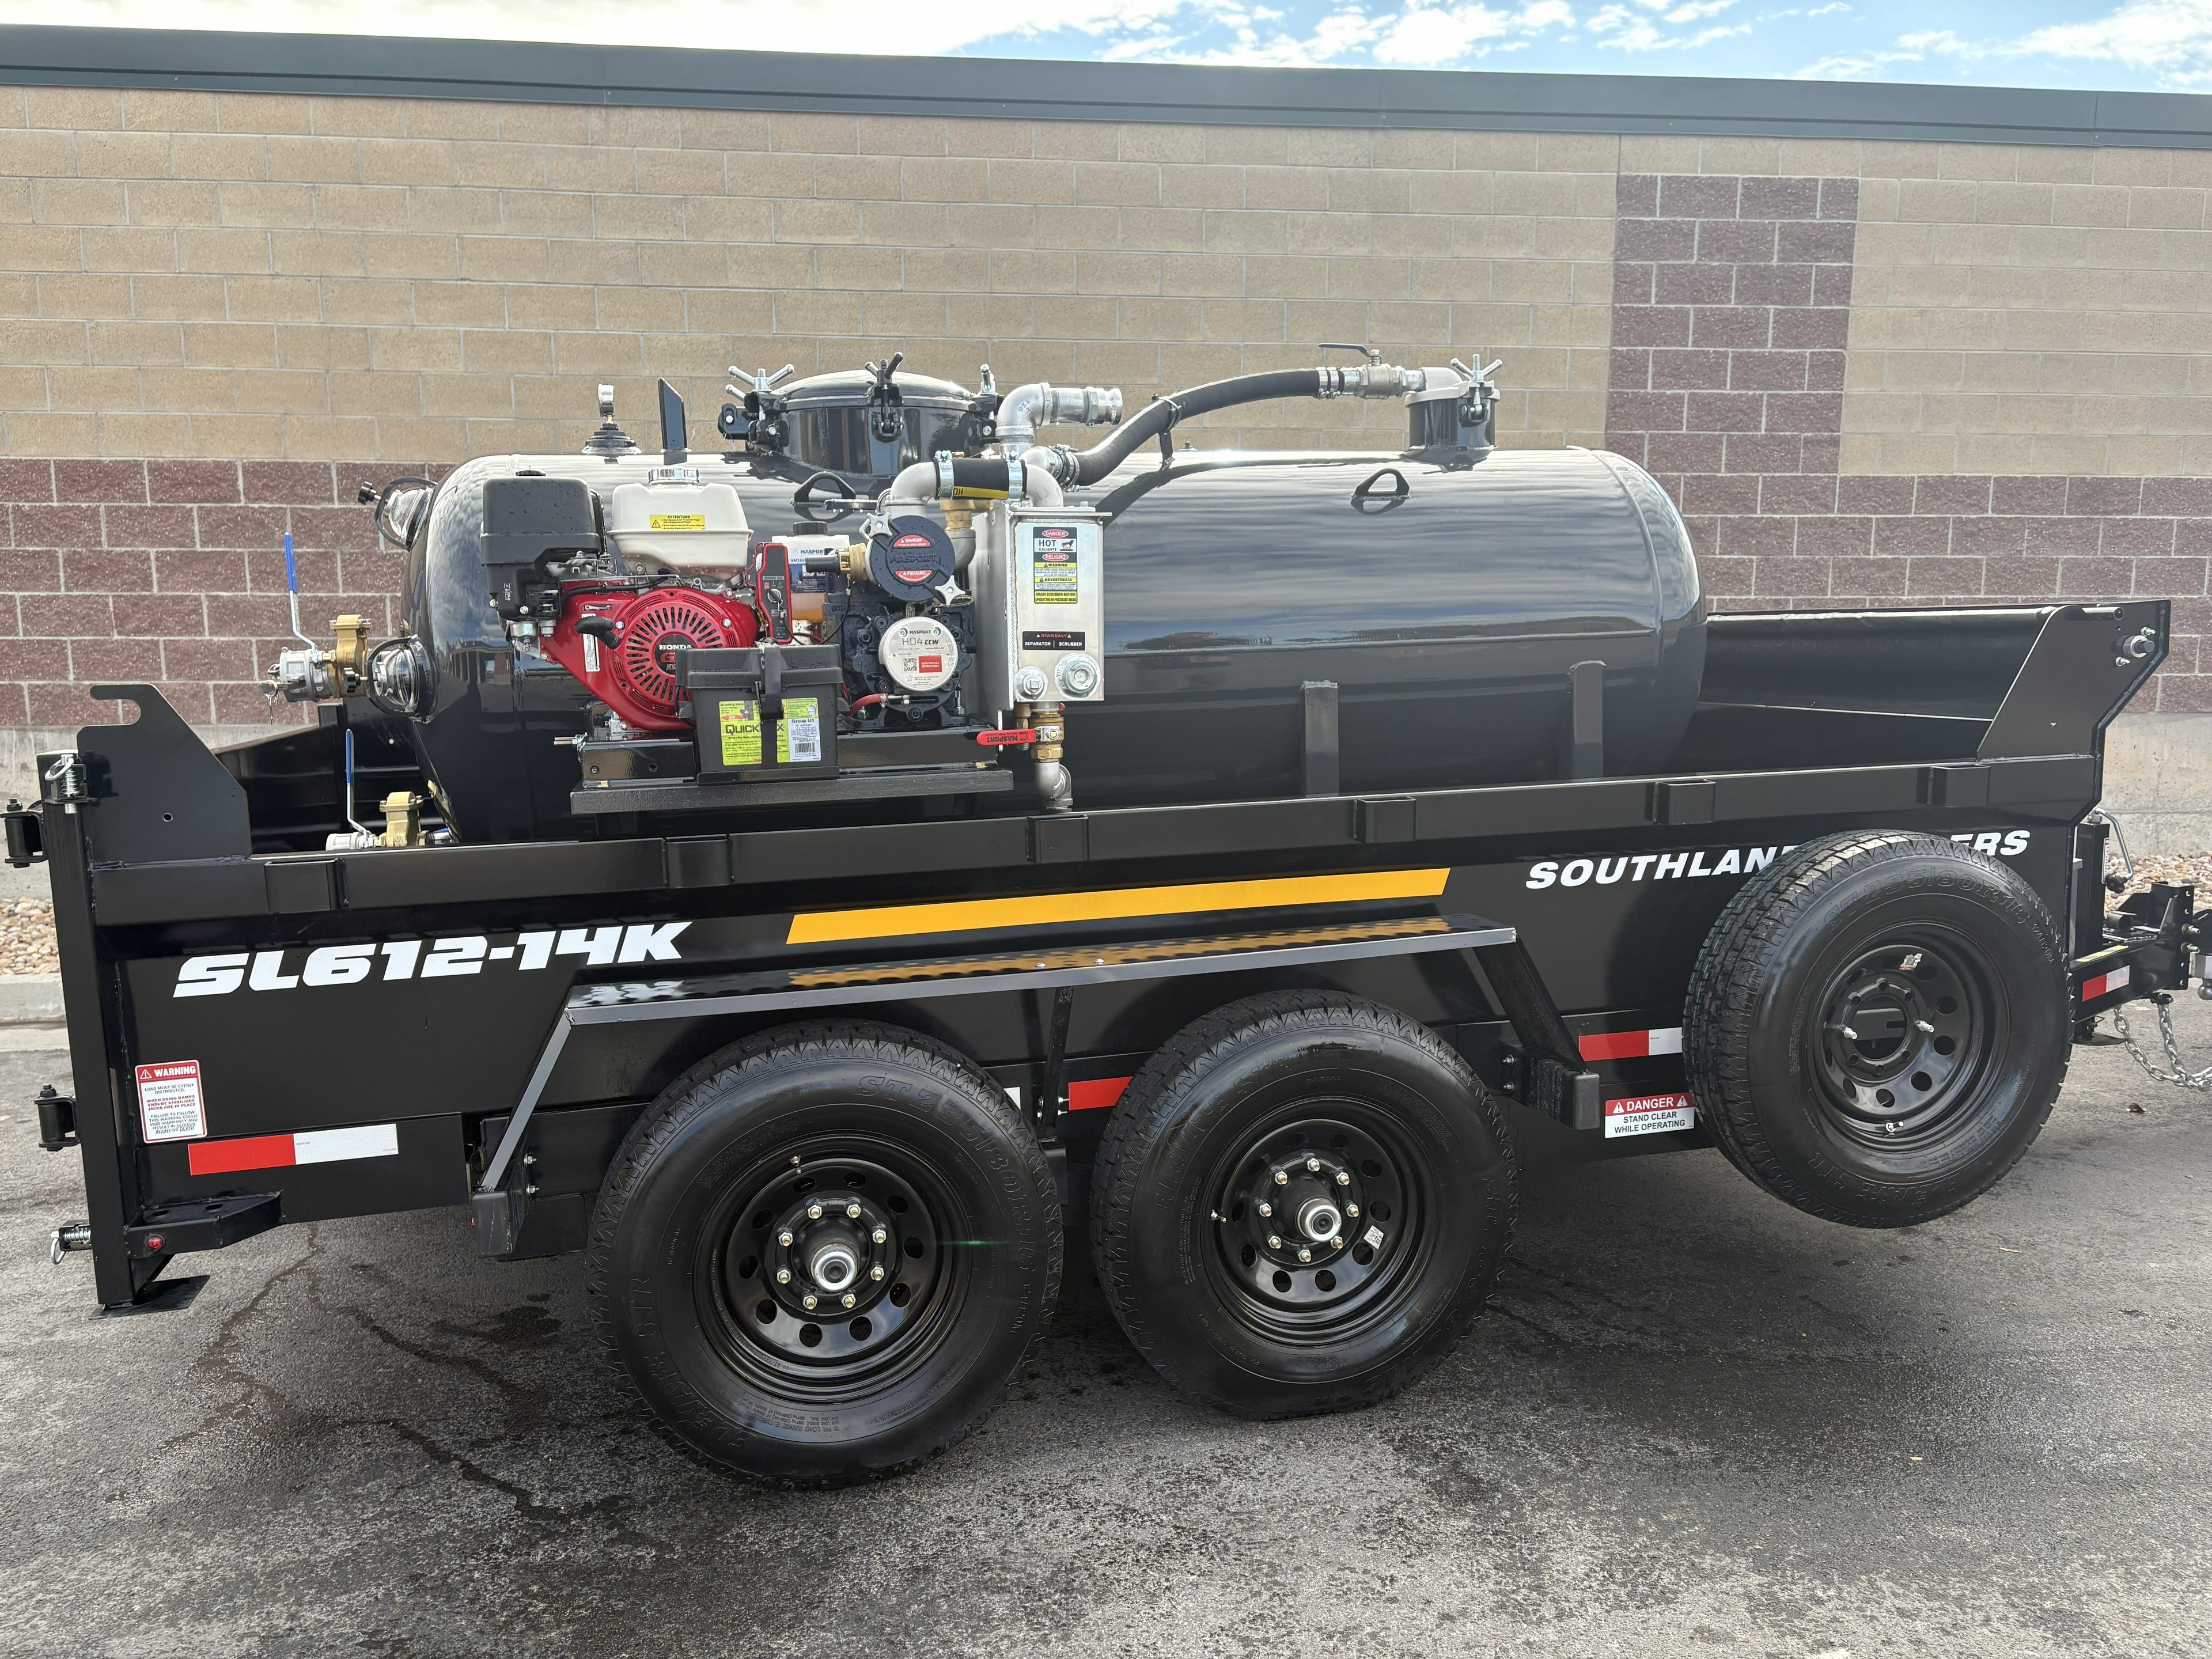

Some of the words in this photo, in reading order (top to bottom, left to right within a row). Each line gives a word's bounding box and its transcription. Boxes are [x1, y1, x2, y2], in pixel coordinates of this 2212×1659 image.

[1039, 539, 1056, 547] HOT
[902, 637, 922, 646] HD4
[1525, 845, 1798, 889] SOUTHLAN
[173, 921, 693, 998] SL612-14K
[154, 1066, 196, 1078] WARNING
[854, 1075, 912, 1101] ST
[1627, 1097, 1674, 1111] DANGER
[1623, 1115, 1649, 1123] STAND
[1651, 1111, 1677, 1120] CLEAR
[1615, 1124, 1639, 1134] WHILE
[1641, 1119, 1685, 1131] OPERATING
